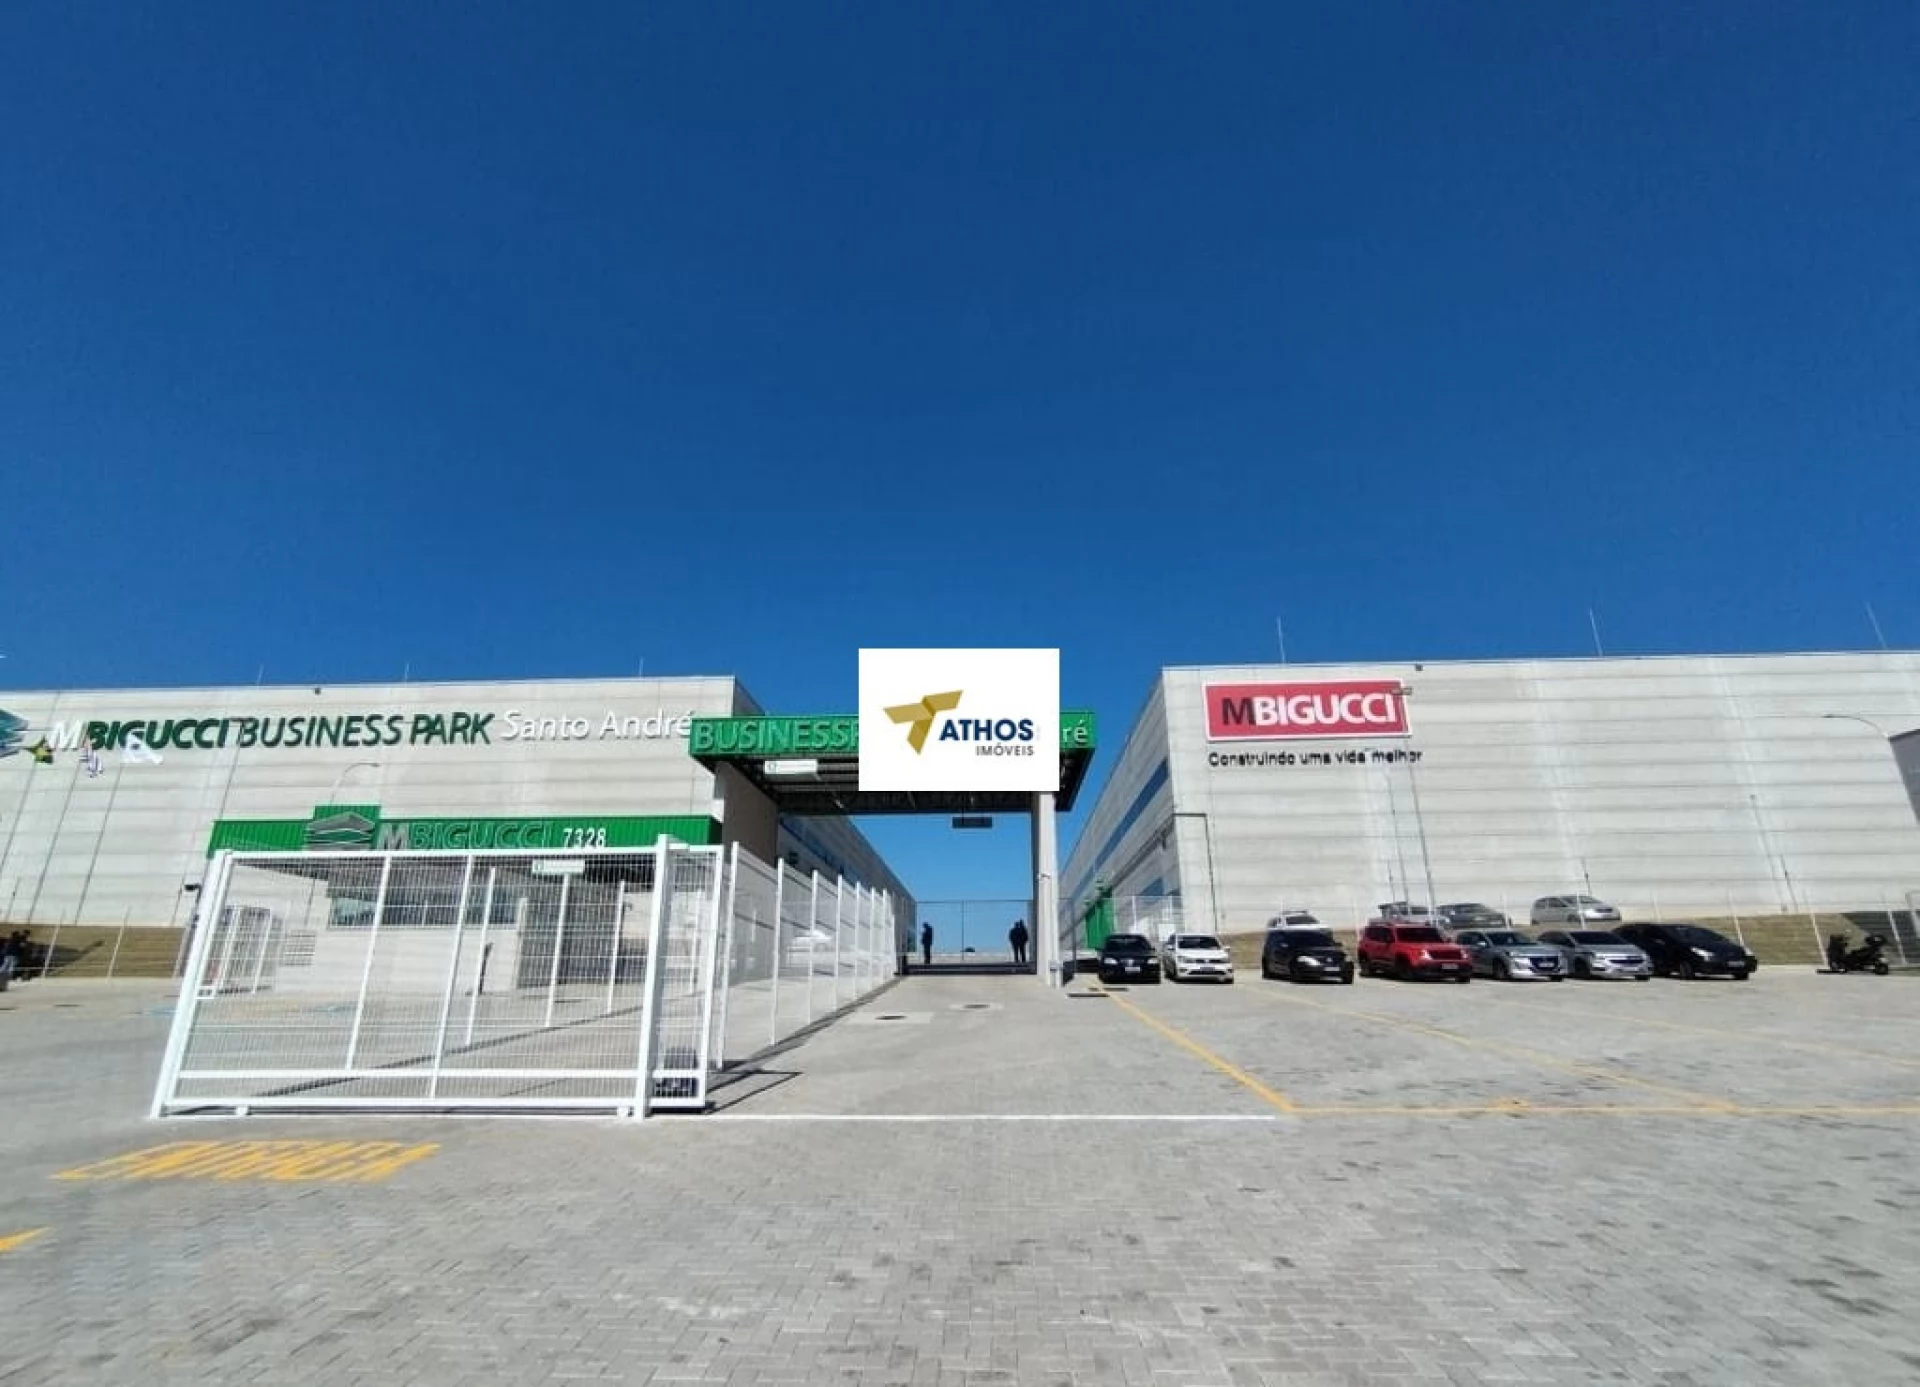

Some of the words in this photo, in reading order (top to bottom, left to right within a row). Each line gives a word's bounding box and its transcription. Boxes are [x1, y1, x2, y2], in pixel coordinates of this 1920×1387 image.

[1222, 693, 1397, 726] MBIGUCCI
[237, 714, 404, 748] BUSINESS
[410, 711, 495, 745] PARK
[501, 709, 591, 741] Santo
[695, 718, 852, 751] BUSINESS
[1208, 751, 1296, 767] Construindo
[1301, 752, 1332, 766] uma
[1335, 749, 1367, 765] vida
[1371, 748, 1424, 764] melhor
[375, 821, 548, 850] MBIGUCCI
[563, 827, 607, 848] 7328
